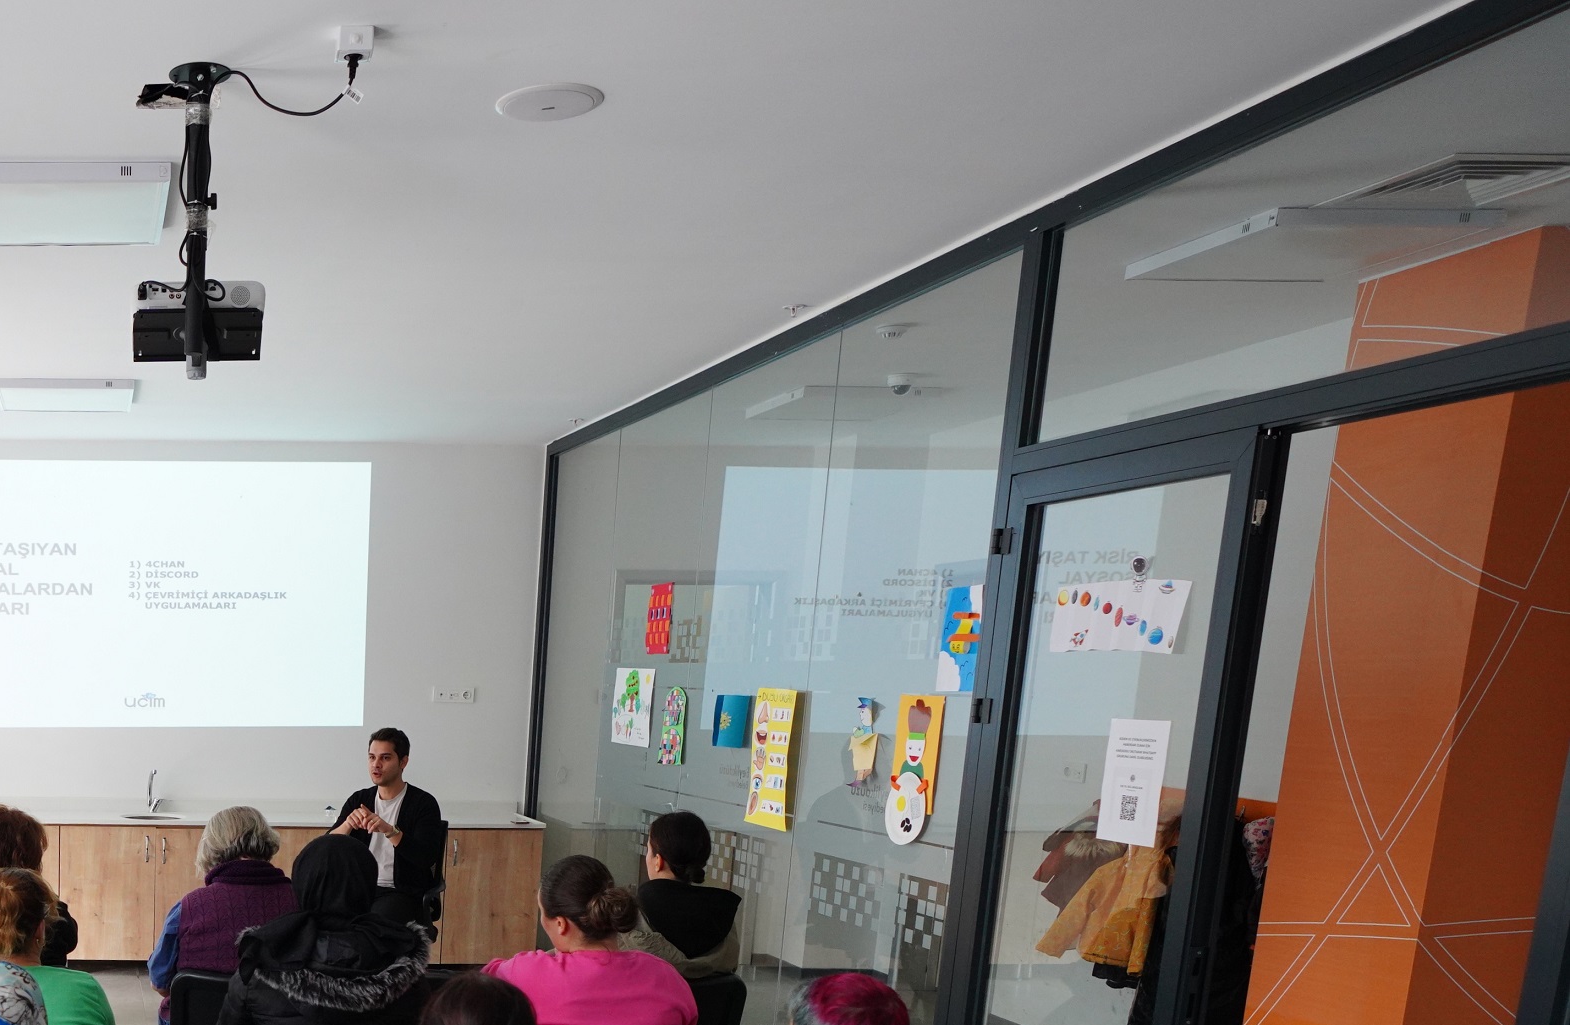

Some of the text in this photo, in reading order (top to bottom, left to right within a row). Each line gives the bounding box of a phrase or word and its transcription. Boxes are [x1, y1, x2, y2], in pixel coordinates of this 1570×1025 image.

[129, 560, 185, 569] 1) 4CHAN
[129, 569, 199, 580] 2) DİSCORD
[128, 581, 161, 590] 3) VK
[128, 590, 287, 600] 4) ÇEVRİMİÇİ ARKADAŞLIK
[145, 602, 237, 610] UYGULAMALARI
